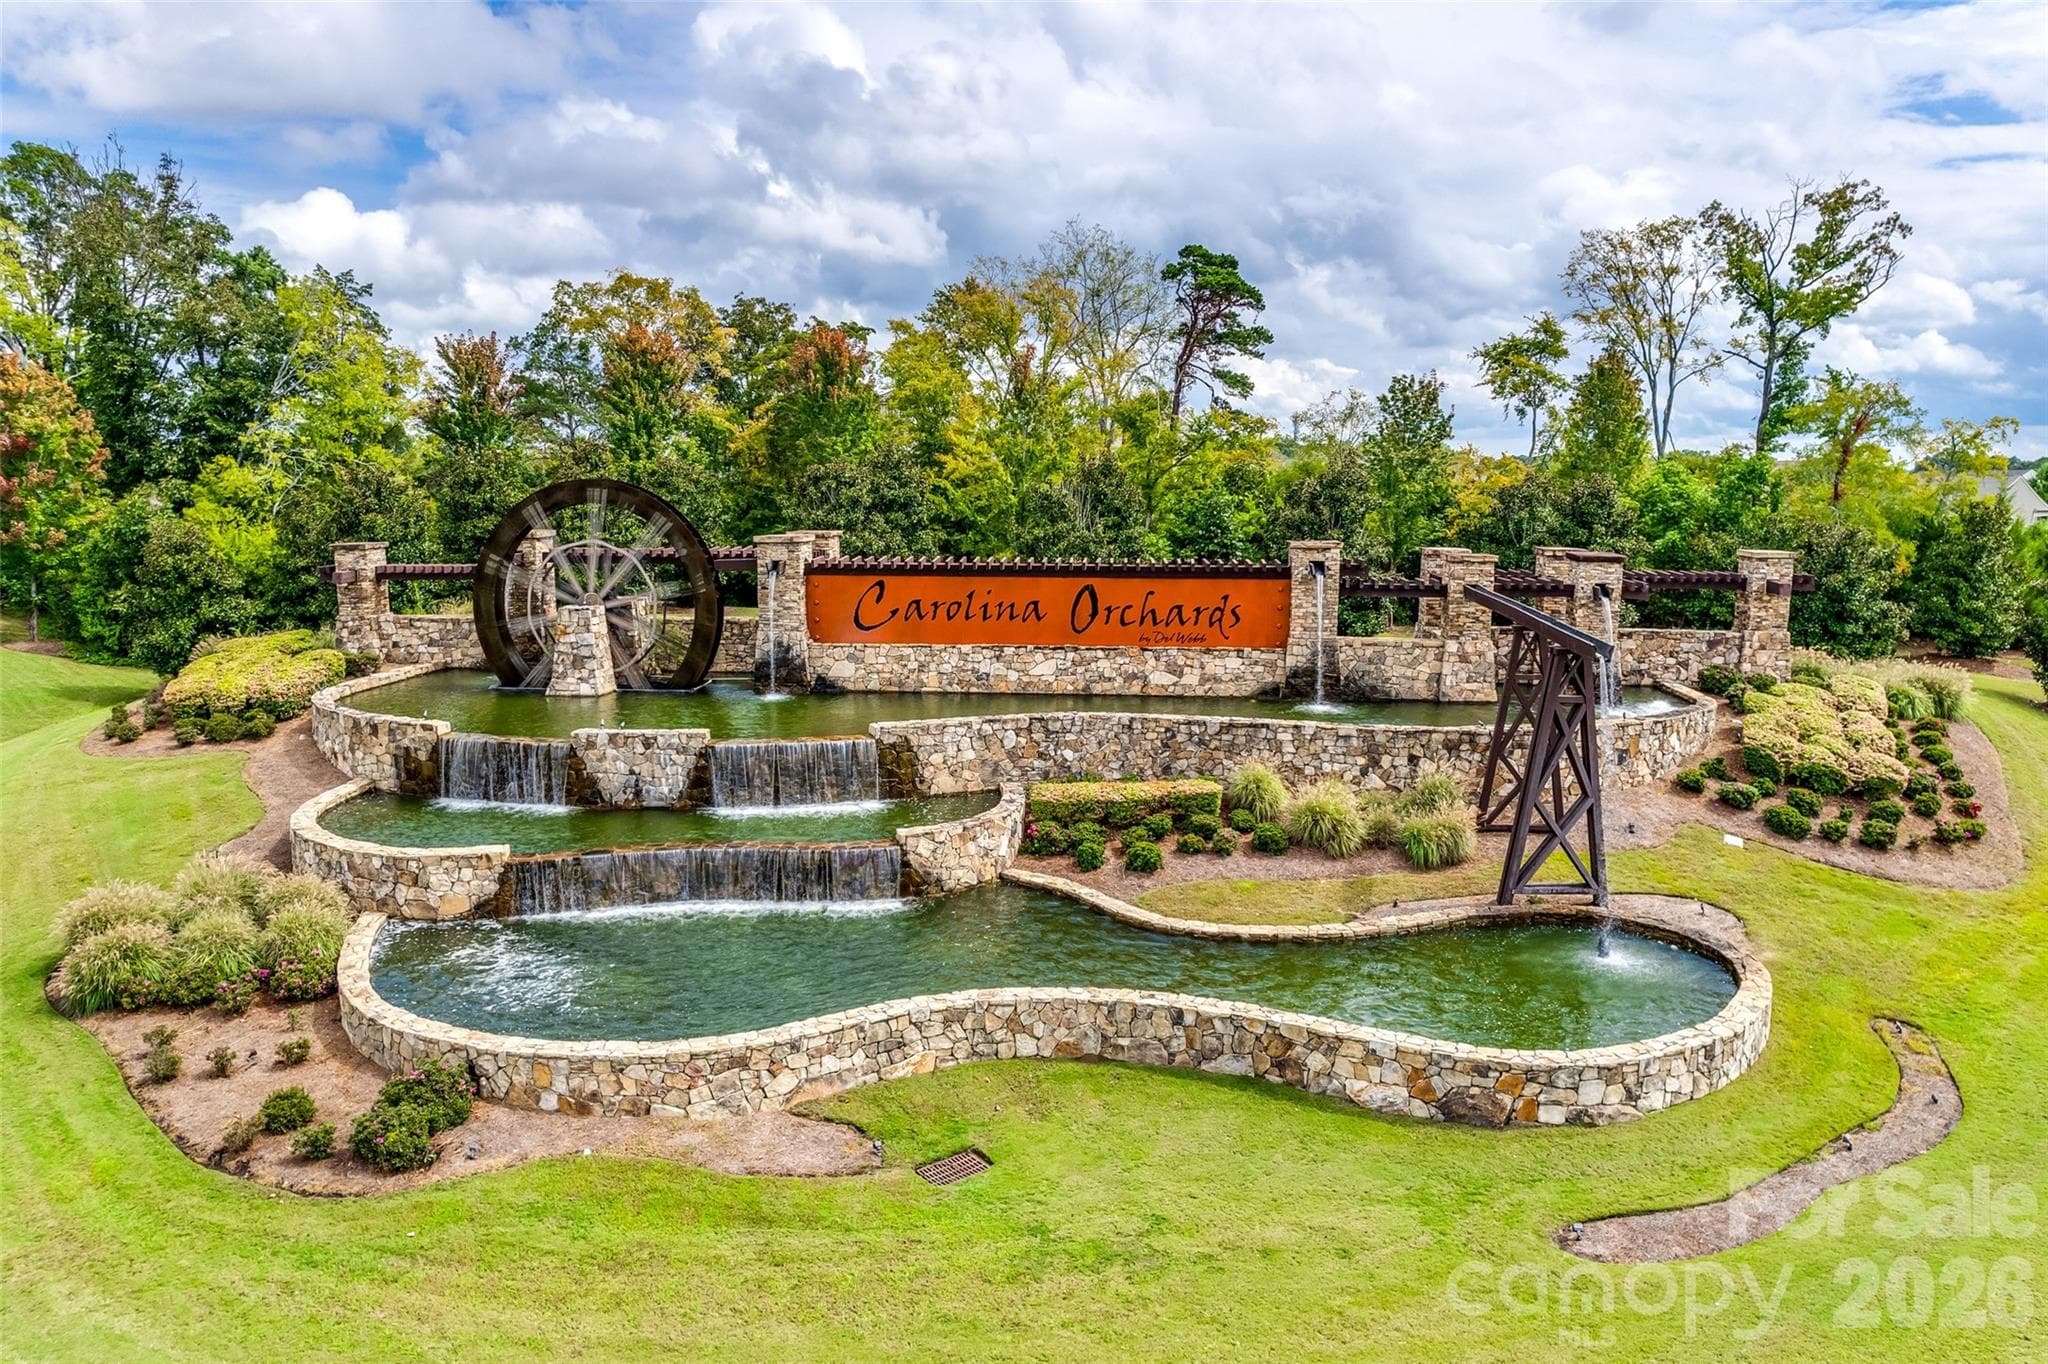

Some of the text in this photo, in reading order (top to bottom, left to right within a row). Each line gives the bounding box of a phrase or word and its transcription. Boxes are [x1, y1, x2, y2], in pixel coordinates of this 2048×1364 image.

[853, 579, 1242, 639] Carolina Orchards
[1139, 630, 1207, 646] by Del Webb
